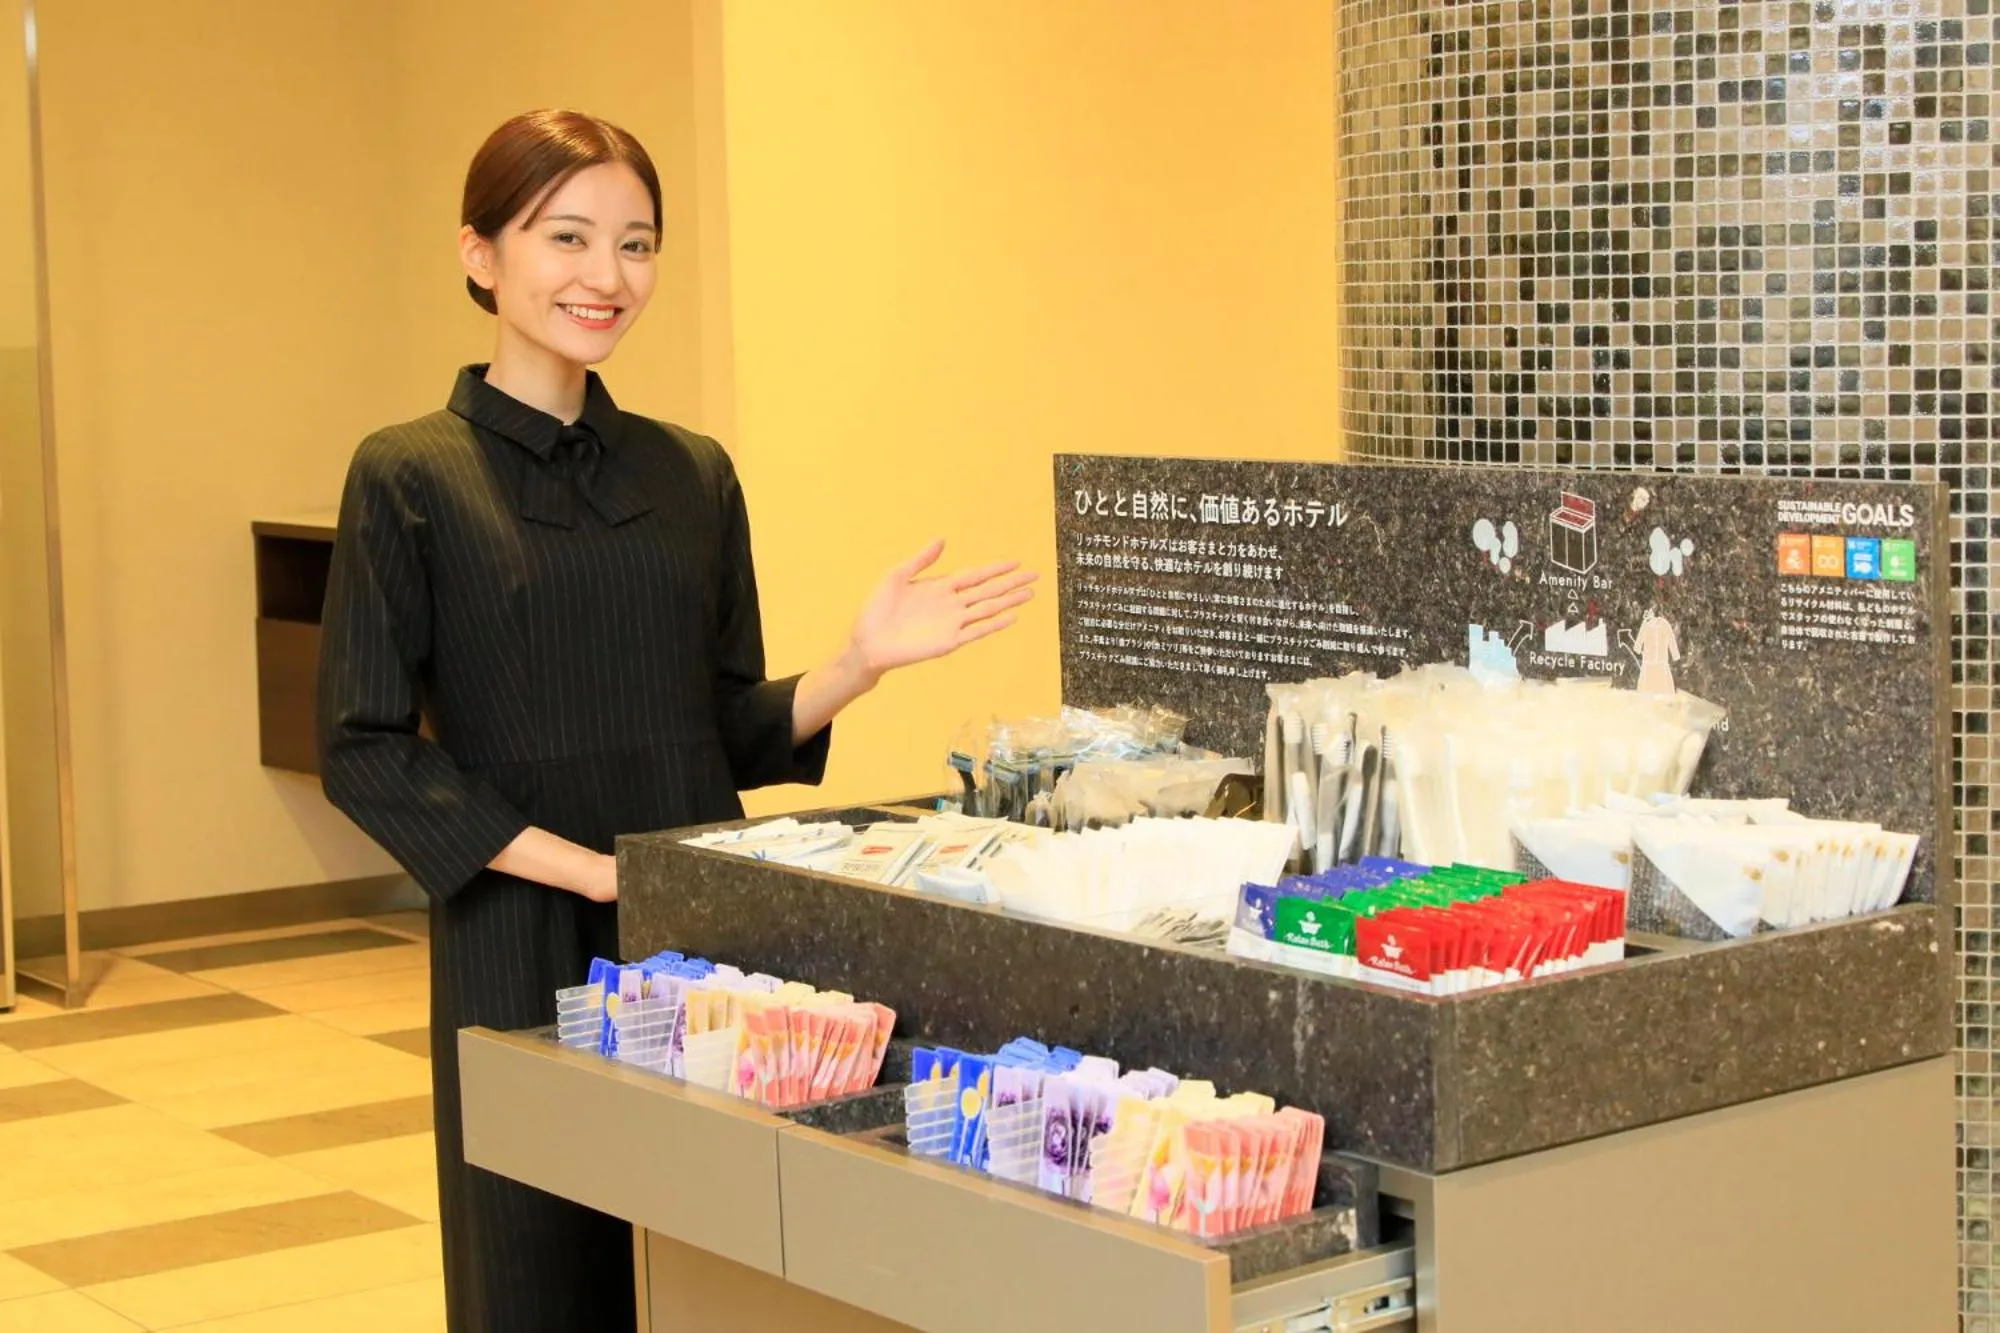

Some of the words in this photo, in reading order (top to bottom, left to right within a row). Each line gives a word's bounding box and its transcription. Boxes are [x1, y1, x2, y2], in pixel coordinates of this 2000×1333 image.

[1075, 489, 1348, 528] ひとと自然に、価値あるホテル
[1778, 500, 1841, 513] SUSTAINABLE
[1842, 503, 1914, 527] GOALS
[1778, 512, 1841, 525] DEVELOPMENT
[1076, 533, 1283, 560] リッチモンドホテルズはお客さまと力をあわせ、
[1076, 552, 1284, 580] 未来の自然を守る、快適なホテルを創り続けます
[1539, 570, 1587, 592] Amenity
[1593, 575, 1613, 590] Bar
[1781, 640, 1807, 651] ります。
[1529, 651, 1575, 670] Recycle
[1581, 656, 1625, 676] Factory
